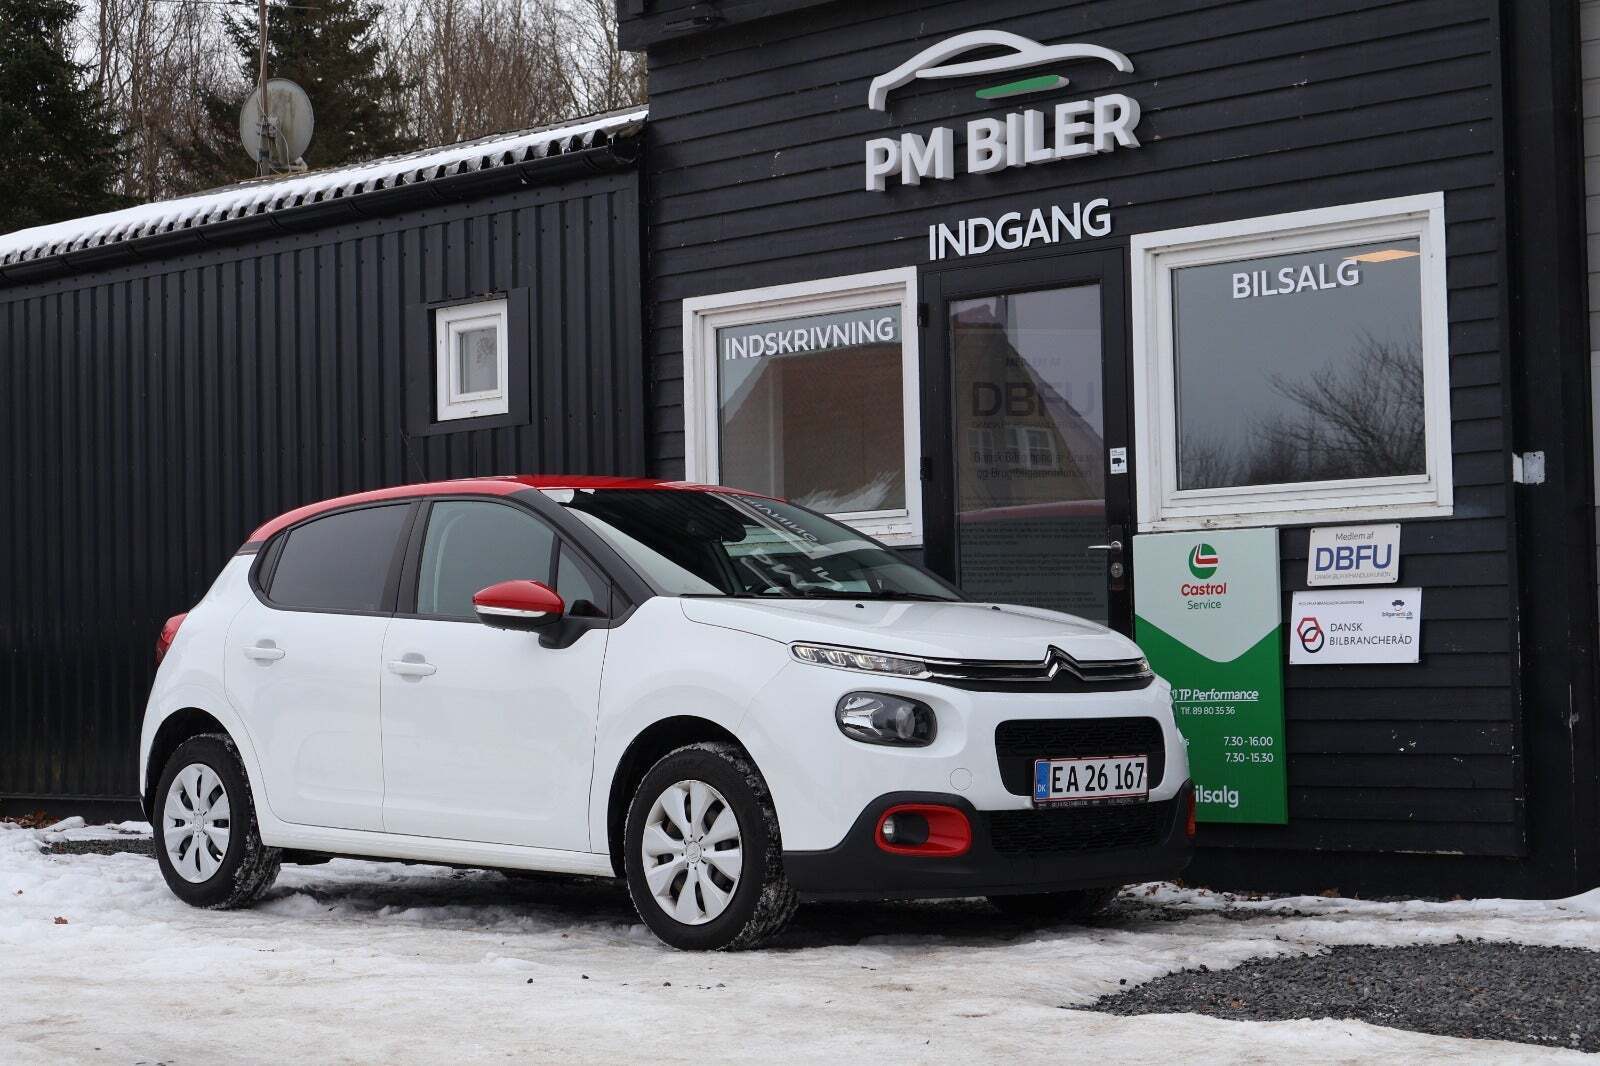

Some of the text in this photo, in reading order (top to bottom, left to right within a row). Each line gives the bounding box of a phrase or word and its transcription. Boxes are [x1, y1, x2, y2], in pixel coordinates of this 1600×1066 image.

[866, 94, 1141, 191] PM BILER
[929, 198, 1111, 261] INDGANG
[1232, 259, 1360, 299] BILSALG
[725, 316, 894, 360] INDSKRIVNING
[1336, 531, 1375, 541] Medlem af
[1316, 544, 1392, 571] DBFU
[1181, 582, 1227, 596] Castrol
[1187, 600, 1222, 610] Service
[1330, 622, 1363, 632] DANSK
[1329, 635, 1412, 646] BILBRANCHERÅD
[1179, 688, 1259, 700] TP Performance
[1181, 707, 1236, 715] Tlf. 89 80 35 36
[1052, 762, 1144, 793] EA 26 167
[1037, 784, 1046, 793] DK
[1195, 785, 1239, 808] ilsalg
